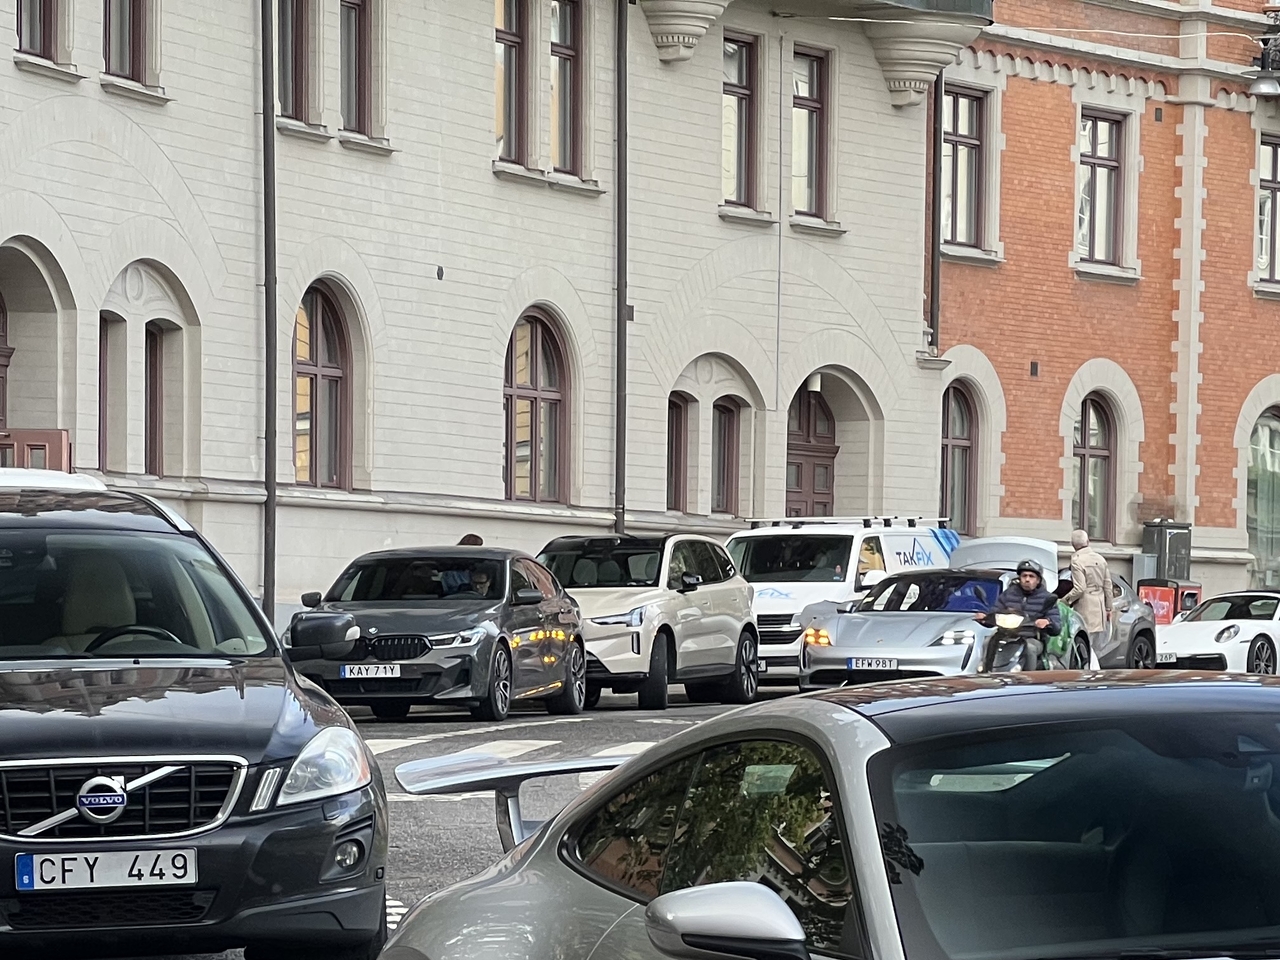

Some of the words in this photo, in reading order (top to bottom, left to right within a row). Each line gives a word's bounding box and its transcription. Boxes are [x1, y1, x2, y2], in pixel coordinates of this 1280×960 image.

[896, 544, 935, 567] TAKFIX
[855, 658, 874, 669] EFW
[875, 658, 894, 669] 98T
[349, 665, 370, 677] KAY
[373, 665, 396, 676] 71Y
[80, 795, 123, 805] VOLVO
[39, 856, 99, 885] CFY
[127, 853, 189, 881] 449
